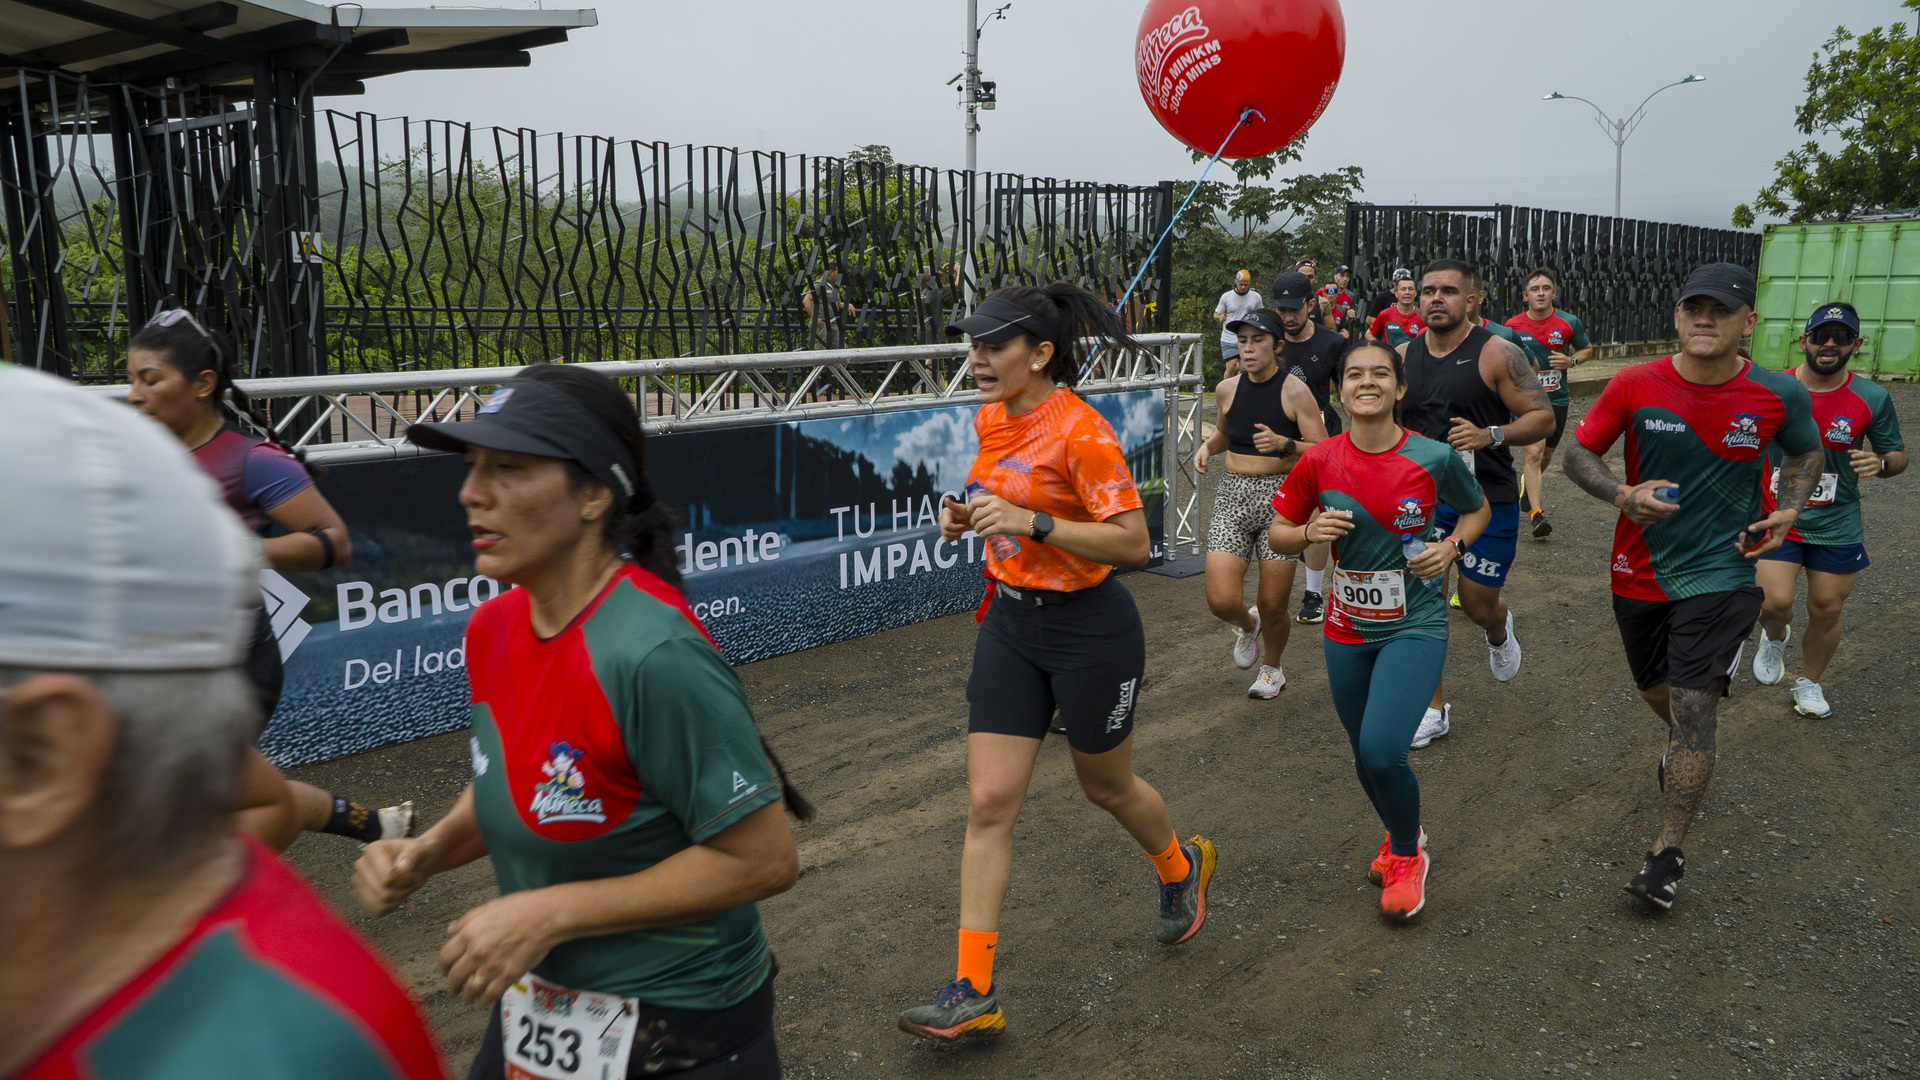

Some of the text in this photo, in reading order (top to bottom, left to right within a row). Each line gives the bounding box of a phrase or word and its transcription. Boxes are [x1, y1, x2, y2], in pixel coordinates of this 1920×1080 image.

[1159, 39, 1221, 110] 6:00 MIN/KM
[1169, 54, 1222, 114] 30:00 MINS
[1540, 376, 1557, 385] 112
[1721, 433, 1761, 446] Muñeca
[830, 490, 971, 542] TU HAC
[839, 531, 987, 589] IMPACT
[336, 574, 499, 632] Banco
[1343, 585, 1383, 606] 900
[343, 636, 467, 690] Del lad
[516, 1014, 582, 1074] 253
